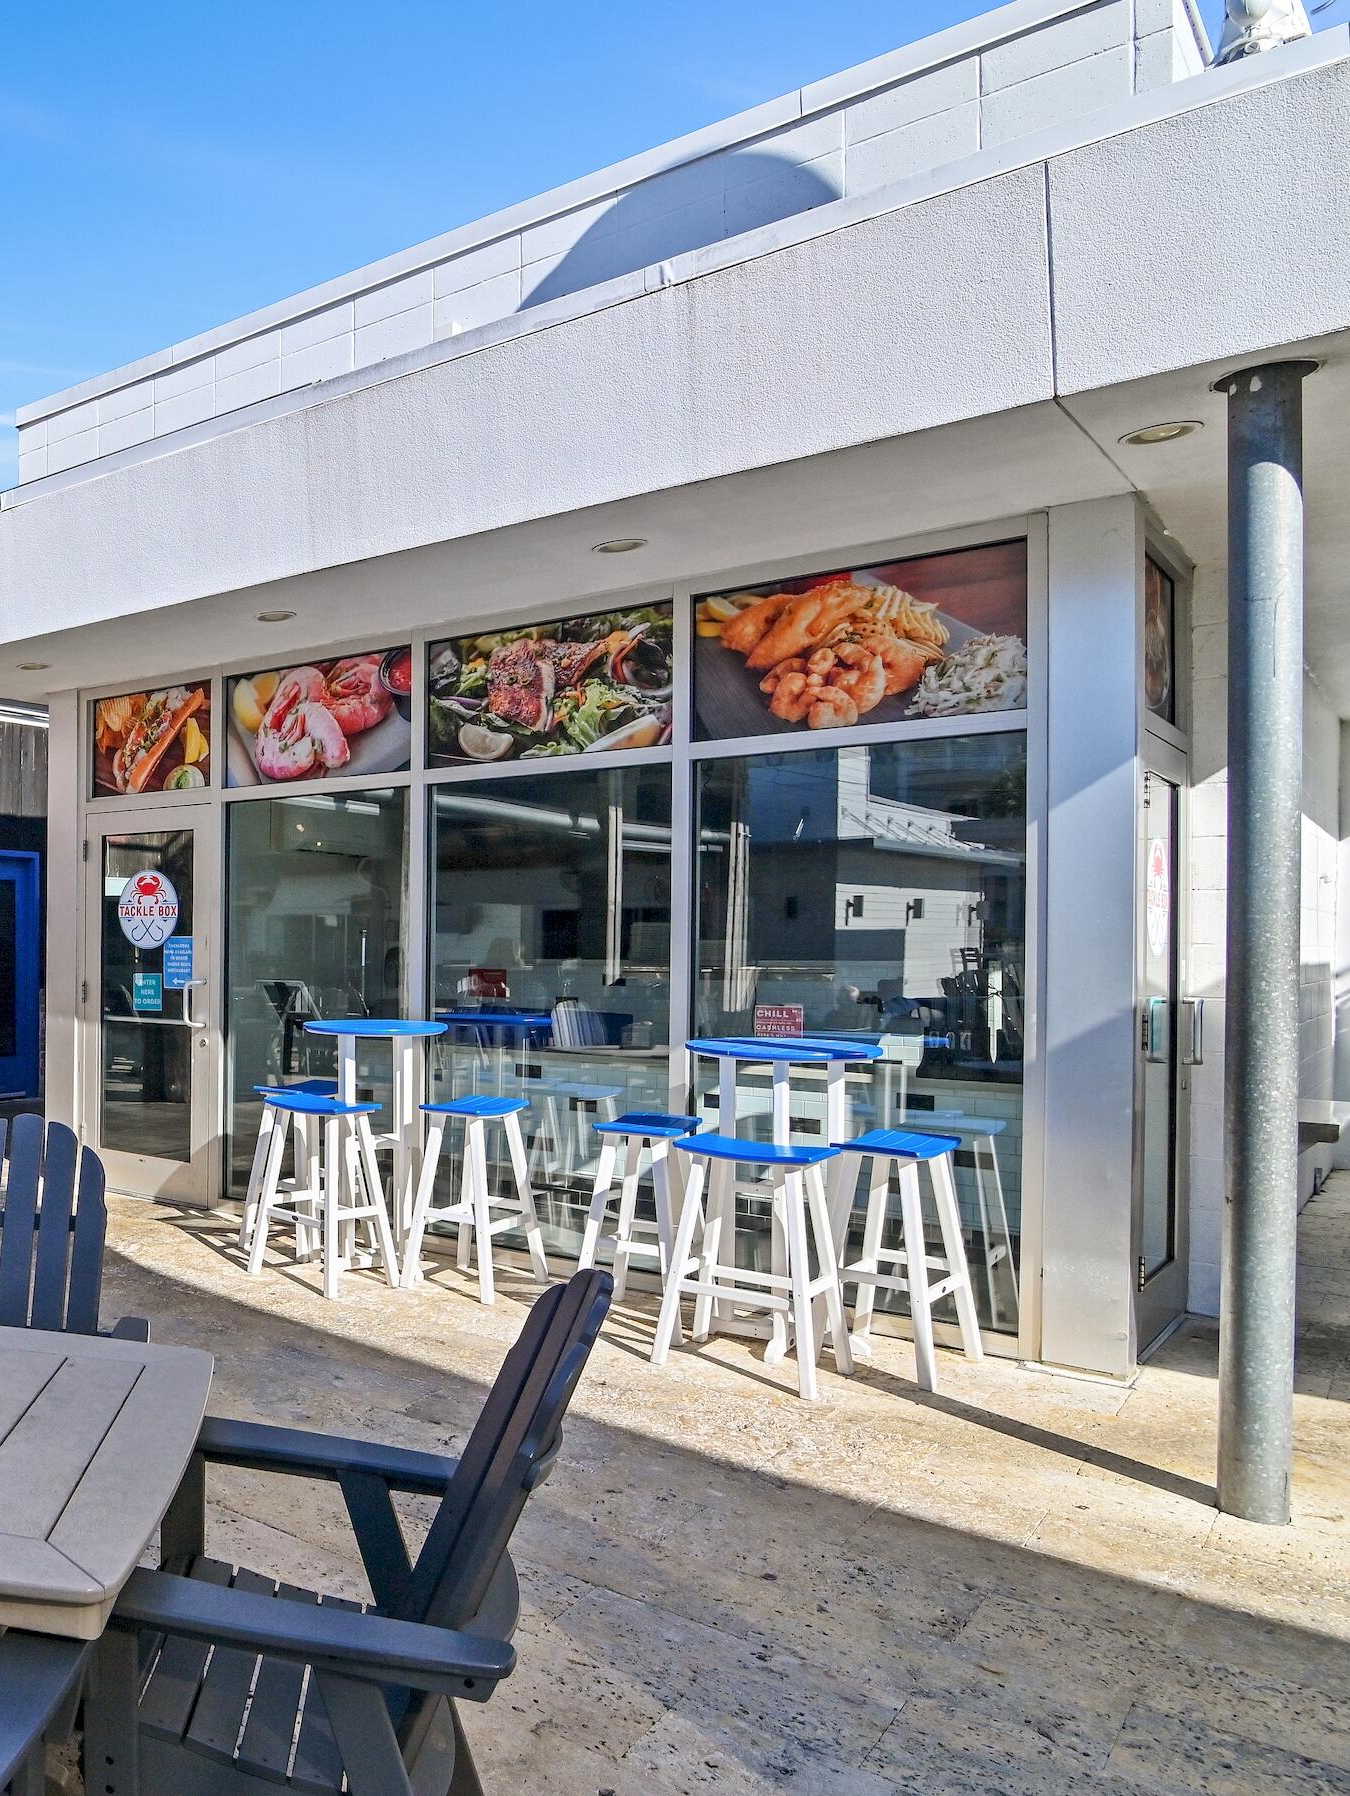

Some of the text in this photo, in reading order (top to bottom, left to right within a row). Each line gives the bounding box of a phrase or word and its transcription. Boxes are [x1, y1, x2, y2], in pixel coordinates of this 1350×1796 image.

[119, 905, 177, 917] TACKLE BOX
[756, 1010, 789, 1018] CHILL
